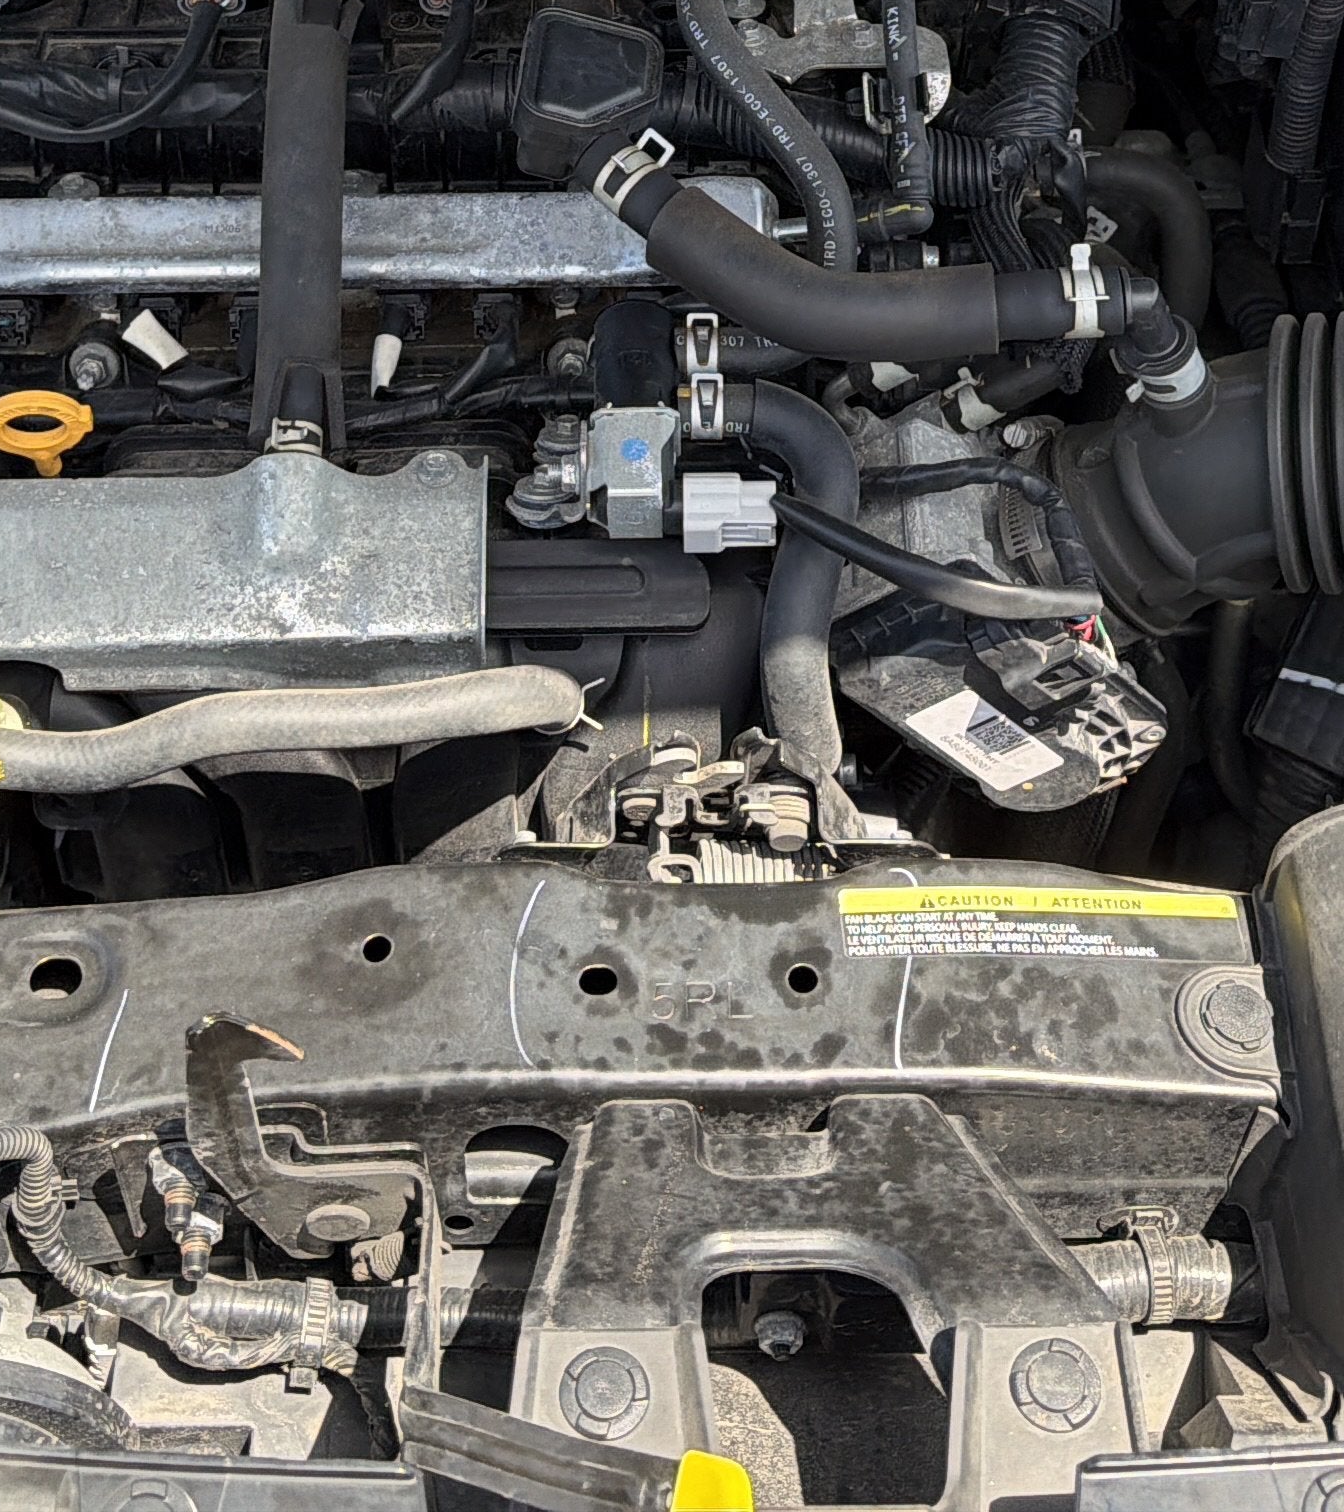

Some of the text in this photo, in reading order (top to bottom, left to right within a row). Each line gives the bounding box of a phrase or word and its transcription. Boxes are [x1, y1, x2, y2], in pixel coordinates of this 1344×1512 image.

[937, 895, 1013, 907] CAUTION
[1051, 897, 1142, 910] ATTENTION
[845, 914, 864, 924] FAN
[865, 914, 893, 924] BLADE
[894, 913, 914, 923] CAN
[915, 912, 942, 923] START
[943, 912, 954, 922] AT
[955, 911, 976, 922] ANY
[846, 925, 860, 935] TO
[861, 925, 883, 934] HELP
[885, 924, 913, 933] AVOID
[914, 923, 959, 933] PERSONAL
[994, 922, 1016, 932] KEEP
[1017, 923, 1048, 933] HANDS
[847, 936, 859, 946] LE
[861, 934, 923, 945] VENTILATEUR
[925, 933, 961, 943] RISQUE
[963, 932, 977, 941] DE
[1041, 934, 1068, 944] TOUT
[848, 946, 877, 957] POUR
[912, 943, 945, 954] TOUTE
[997, 944, 1010, 953] NE
[1012, 943, 1031, 953] PAS
[1032, 944, 1045, 954] EN
[1046, 944, 1105, 955] APPROCHER
[1106, 946, 1123, 956] LES
